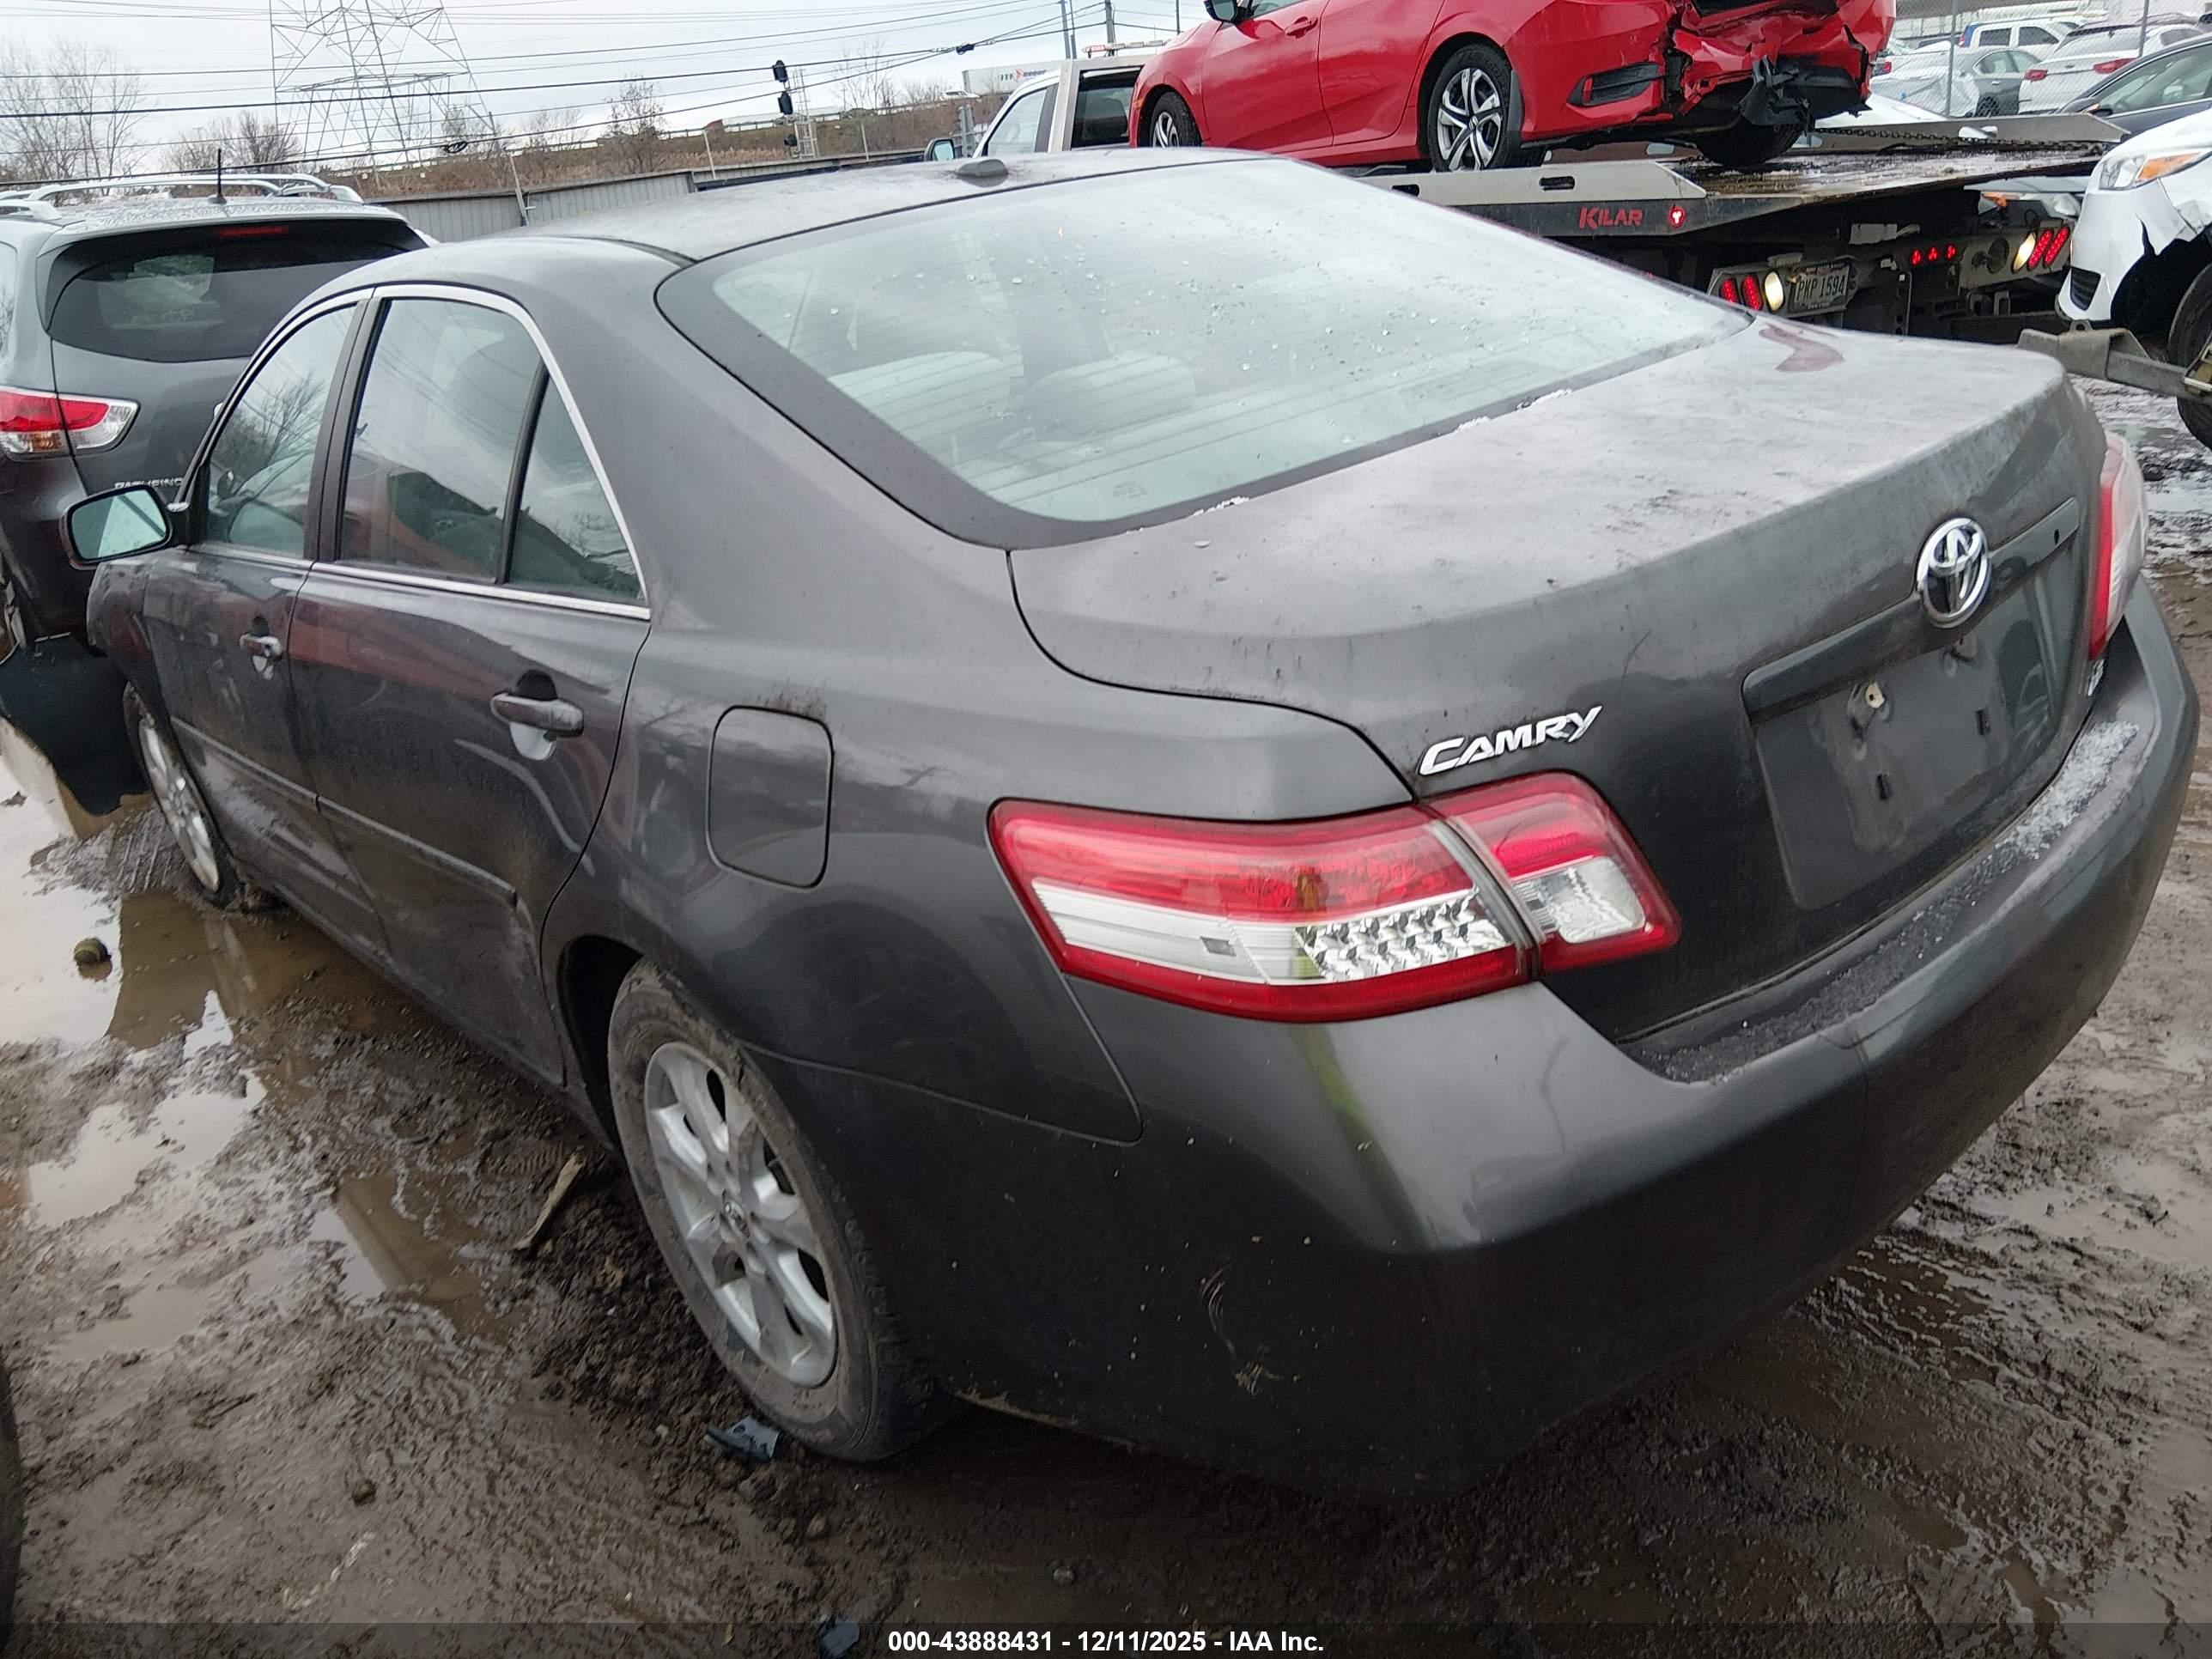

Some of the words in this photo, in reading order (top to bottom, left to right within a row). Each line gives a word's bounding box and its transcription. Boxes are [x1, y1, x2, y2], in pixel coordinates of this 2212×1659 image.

[1578, 205, 1644, 230] KILAR
[1819, 274, 1846, 298] 1594
[1419, 705, 1603, 776] CAMRY
